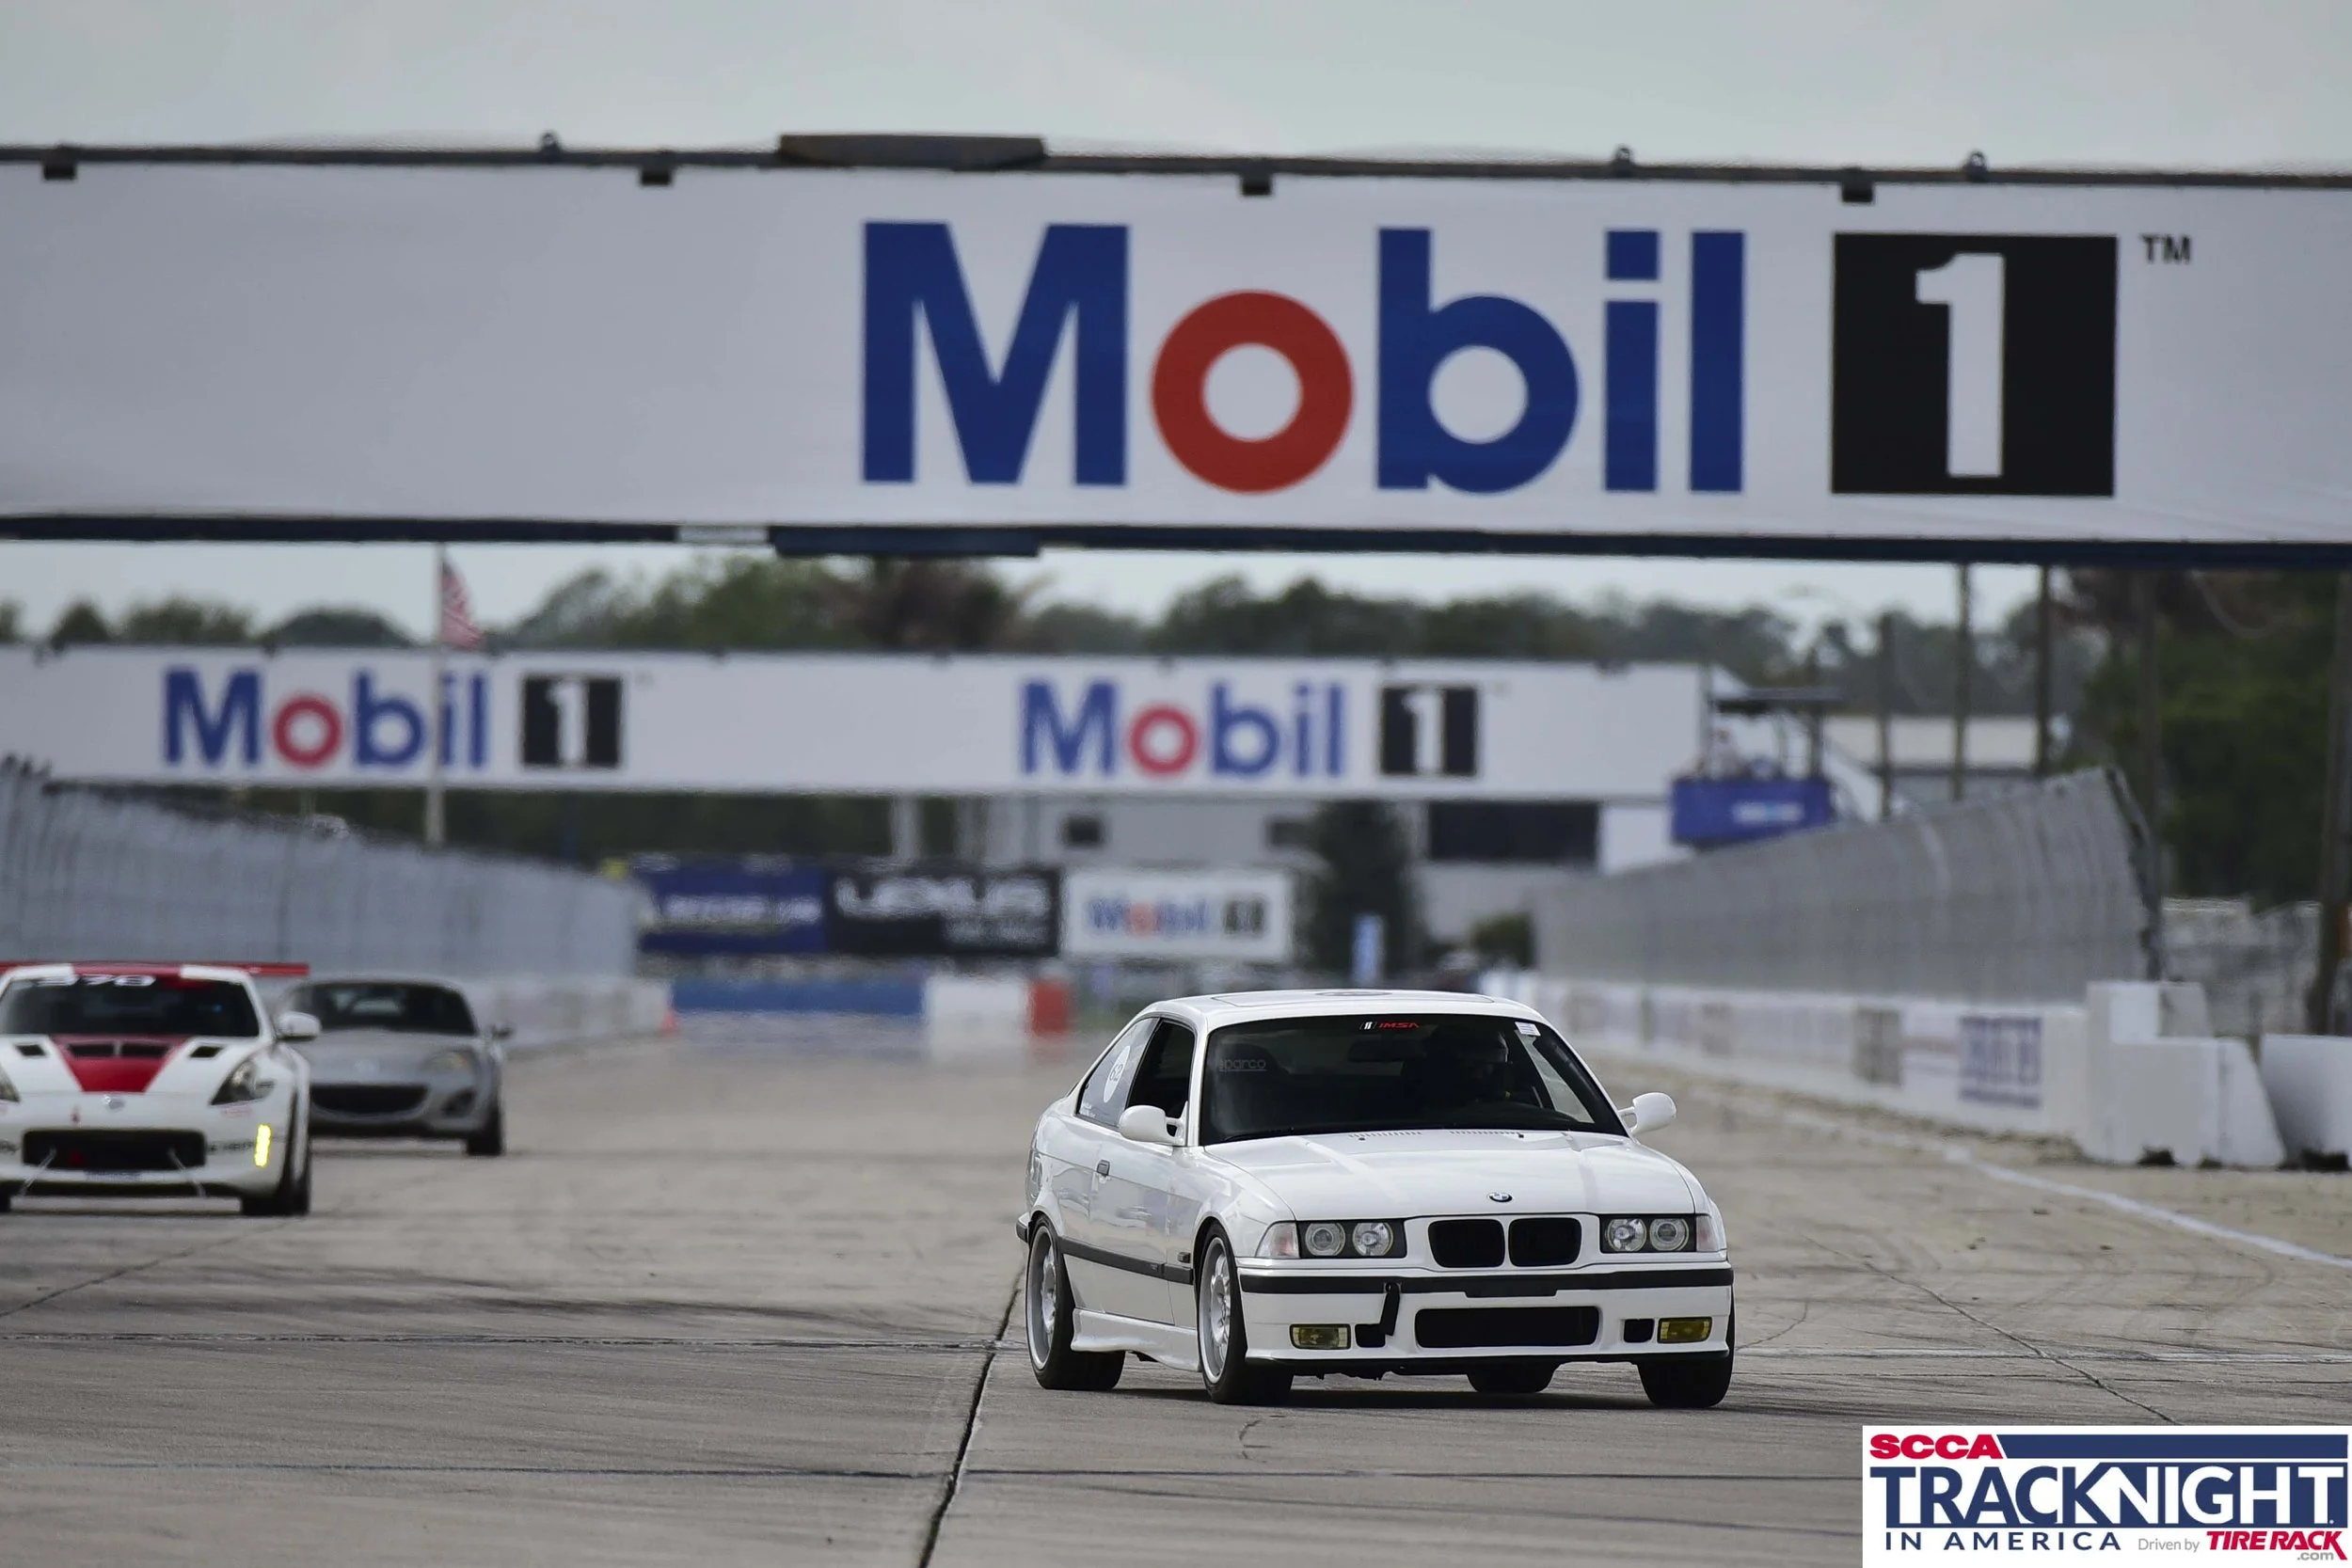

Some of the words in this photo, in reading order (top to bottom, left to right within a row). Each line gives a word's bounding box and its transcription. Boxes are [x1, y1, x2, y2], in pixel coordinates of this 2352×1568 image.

[862, 221, 1746, 496] Mobil
[1914, 251, 2007, 477] 1
[2140, 233, 2192, 264] TM
[164, 668, 489, 768] Mobil
[547, 680, 587, 763] 1
[1021, 679, 1343, 778] Mobil
[1403, 691, 1444, 774] 1
[1110, 1064, 1124, 1082] 62
[1219, 1059, 1266, 1071] sparco
